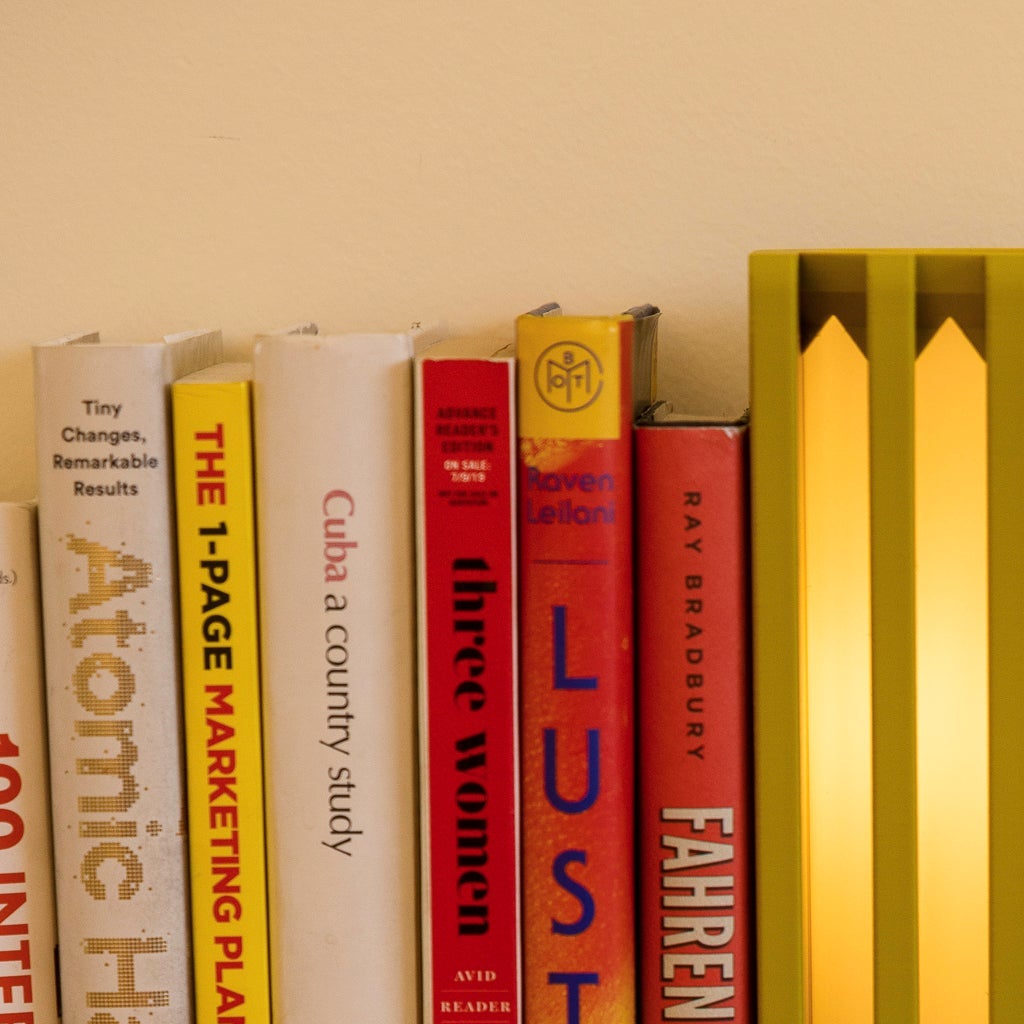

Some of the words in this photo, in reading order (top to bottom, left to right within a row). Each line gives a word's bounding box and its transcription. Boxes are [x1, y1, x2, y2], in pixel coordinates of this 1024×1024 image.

[61, 427, 146, 446] Changes,
[81, 400, 122, 418] Tiny
[53, 454, 158, 469] Remarkable
[74, 481, 138, 496] Results
[195, 423, 226, 506] THE
[527, 467, 614, 492] Raven
[323, 490, 358, 583] Cuba
[527, 499, 615, 525] Leilani
[684, 492, 702, 553] RAY
[199, 522, 232, 670] 1-PAGE
[324, 594, 347, 612] a
[453, 558, 497, 711] three
[685, 575, 704, 759] BRADBURY
[66, 533, 163, 903] Atomic
[319, 625, 354, 755] country
[205, 685, 242, 923] MARKETING
[321, 768, 363, 856] study
[456, 732, 489, 935] women
[441, 1002, 510, 1012] READER
[454, 970, 497, 982] AVID
